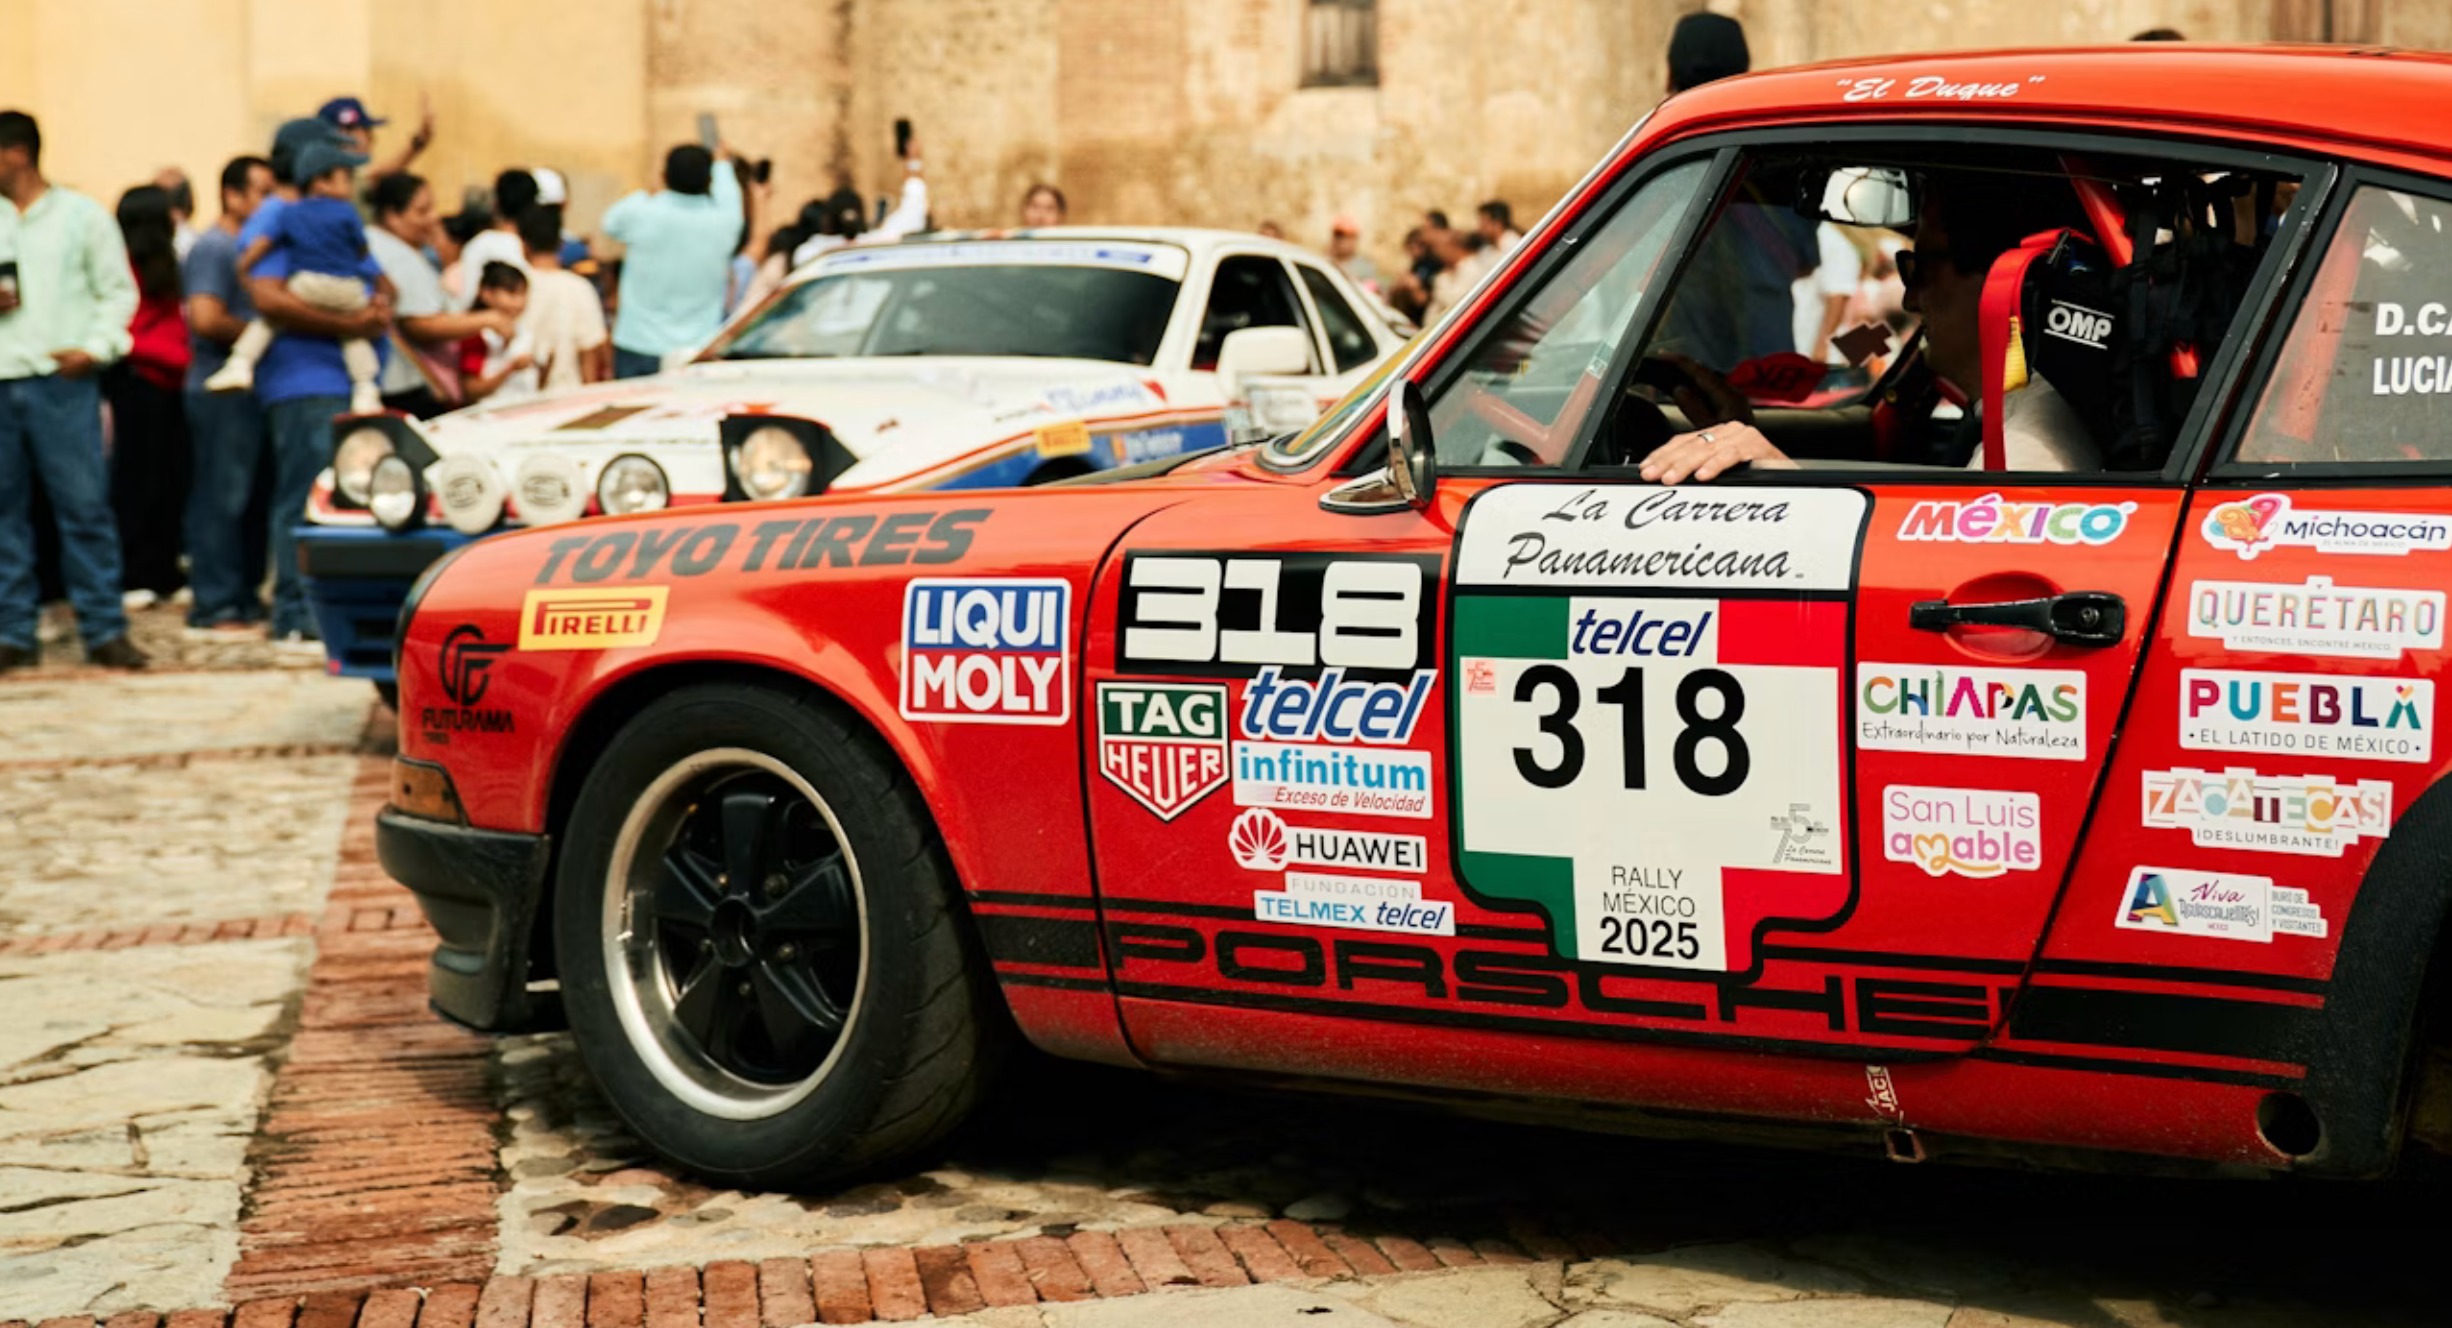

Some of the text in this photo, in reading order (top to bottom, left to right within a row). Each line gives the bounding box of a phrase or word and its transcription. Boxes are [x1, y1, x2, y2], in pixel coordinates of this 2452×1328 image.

[2047, 306, 2112, 342] OMP
[2375, 302, 2452, 336] D.C
[1542, 488, 1791, 530] La Carrera
[2284, 515, 2447, 542] Michoacán
[534, 507, 995, 584] TOYO TIRES
[1503, 531, 1791, 579] Panamericana
[532, 598, 653, 636] PIRELLI
[913, 588, 1058, 650] LIQUI
[1124, 557, 1423, 670] 318
[1572, 608, 1714, 658] telcel
[912, 654, 1062, 712] MOLY
[1245, 670, 1433, 740] telcel
[1862, 669, 2080, 723] CHIAPAS
[2188, 678, 2423, 731] PUEBLA
[1107, 690, 1217, 737] TAG
[1512, 663, 1751, 797] 318
[1862, 719, 2079, 750] Extraordinario por Naturaleza
[2200, 728, 2410, 755] EL LATIDO DE MÉXICO
[1107, 745, 1222, 809] HEUER
[1239, 746, 1426, 792] infinitum
[1274, 785, 1427, 813] Exceso de Velocidad
[1889, 790, 2036, 830] San Luis
[2148, 777, 2384, 835] ZACATECAS
[1295, 832, 1421, 868] HUAWEI
[1611, 865, 1684, 891] RALLY
[1260, 896, 1446, 930] TELMEX telcel
[1602, 888, 1696, 919] MÉXICO
[1599, 915, 1700, 961] 2025
[1108, 921, 1992, 1041] PORSCHE
